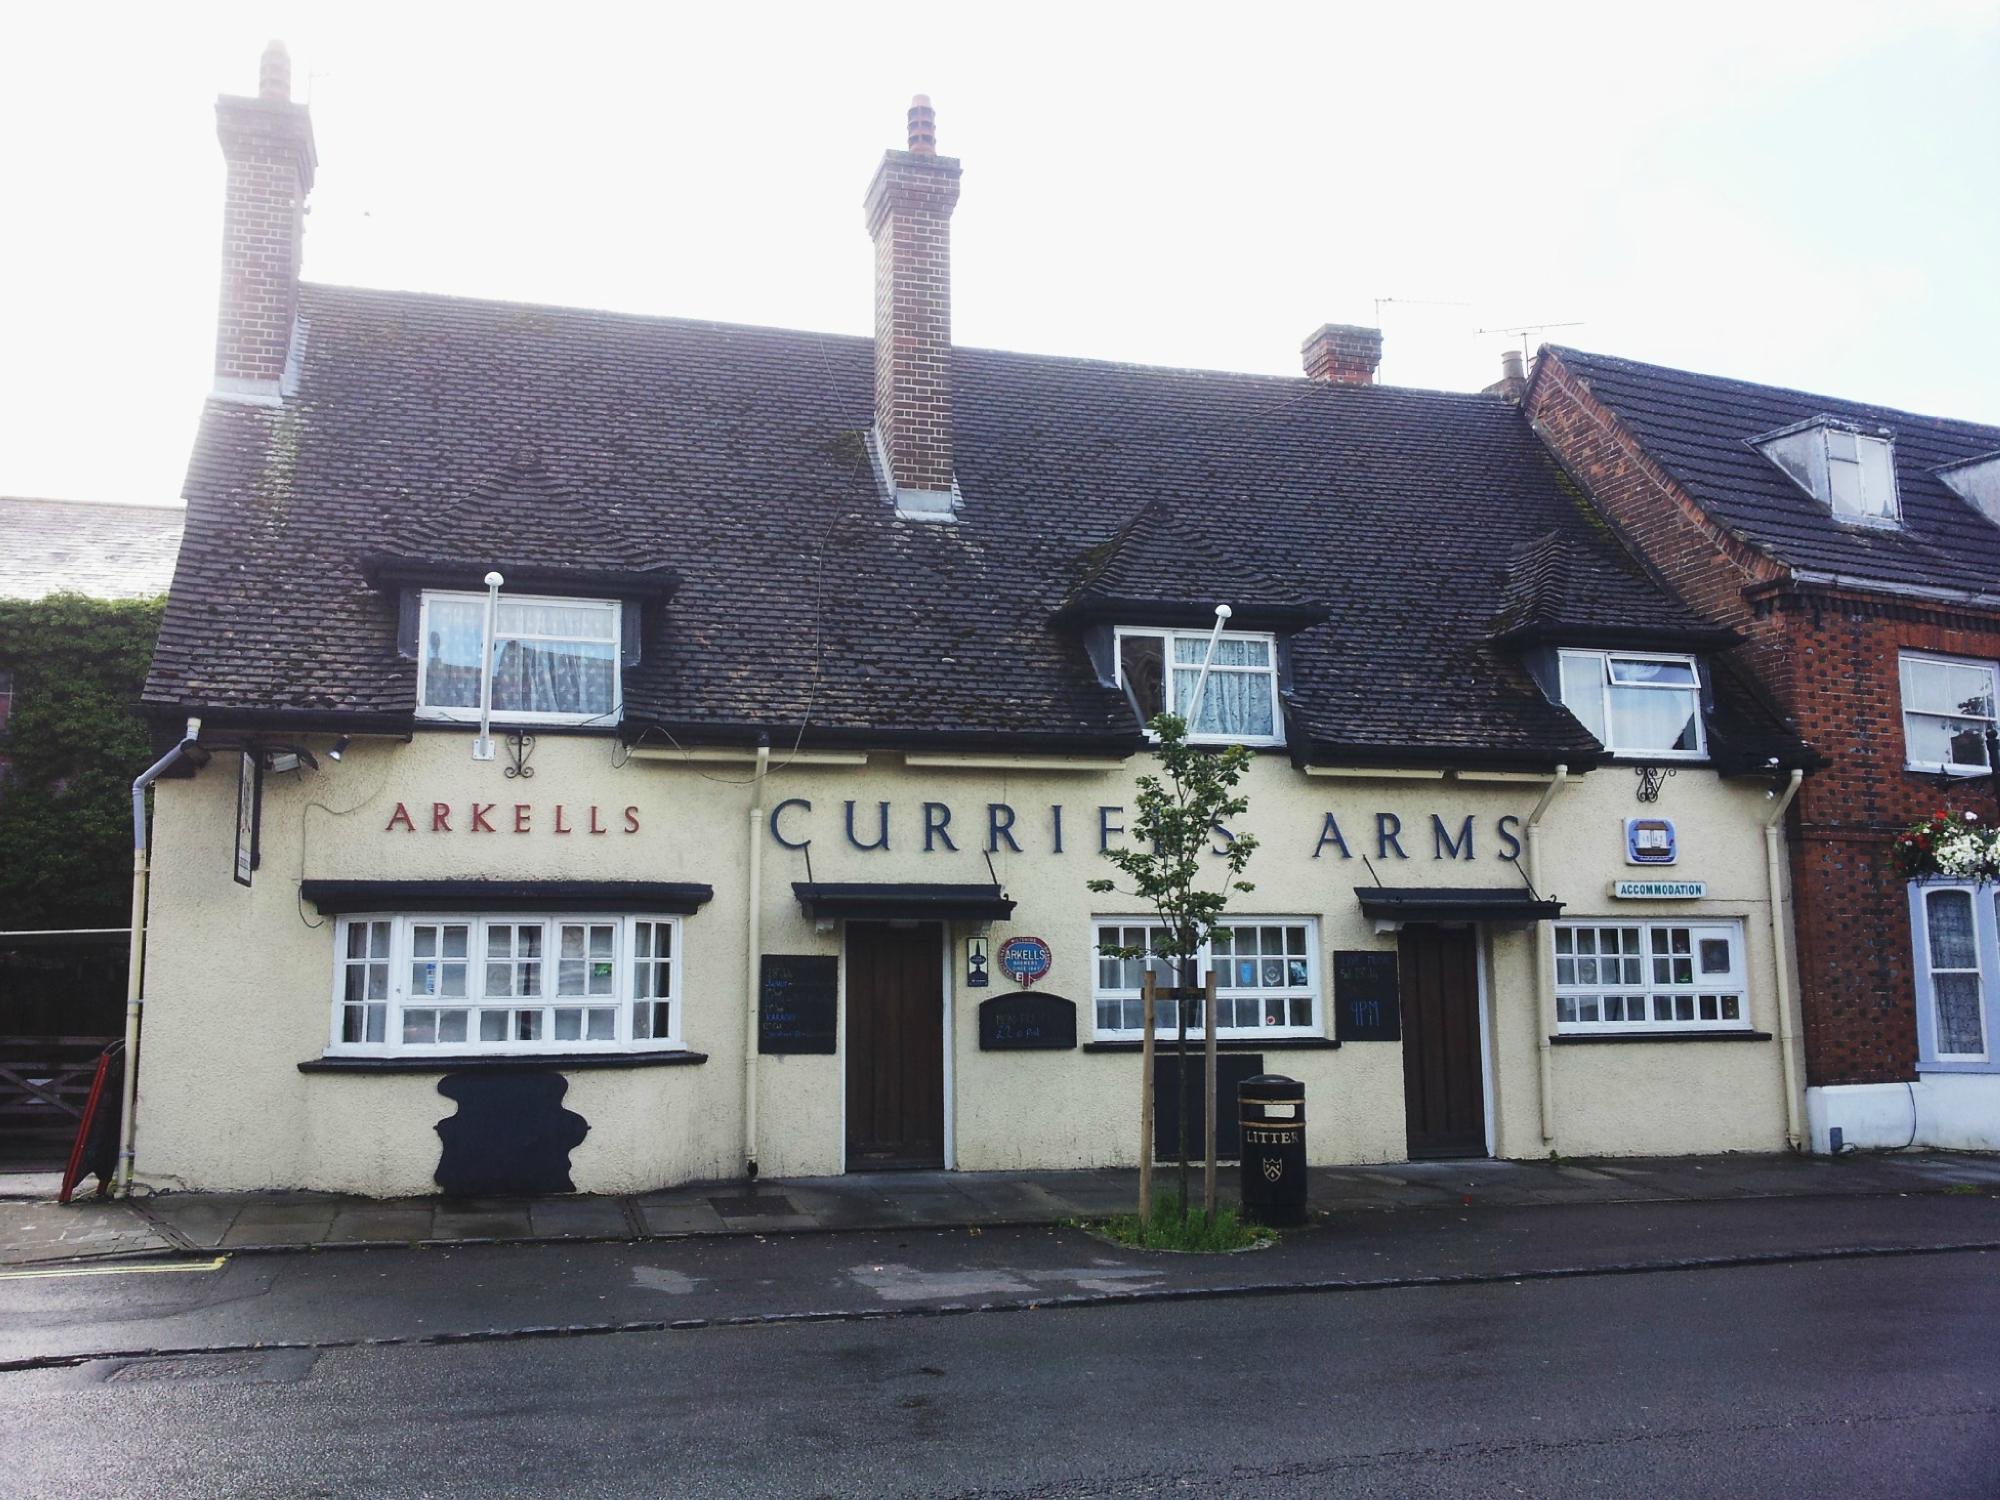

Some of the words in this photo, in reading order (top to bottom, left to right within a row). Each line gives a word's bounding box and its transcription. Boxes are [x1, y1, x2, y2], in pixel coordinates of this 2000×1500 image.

[385, 802, 641, 834] ARKELLS
[770, 799, 1236, 856] CURRIES
[1313, 812, 1522, 861] ARMS
[1620, 884, 1702, 895] ACCOMMODATION
[1005, 949, 1046, 961] ARKELLS
[1247, 1131, 1299, 1144] LITTER
